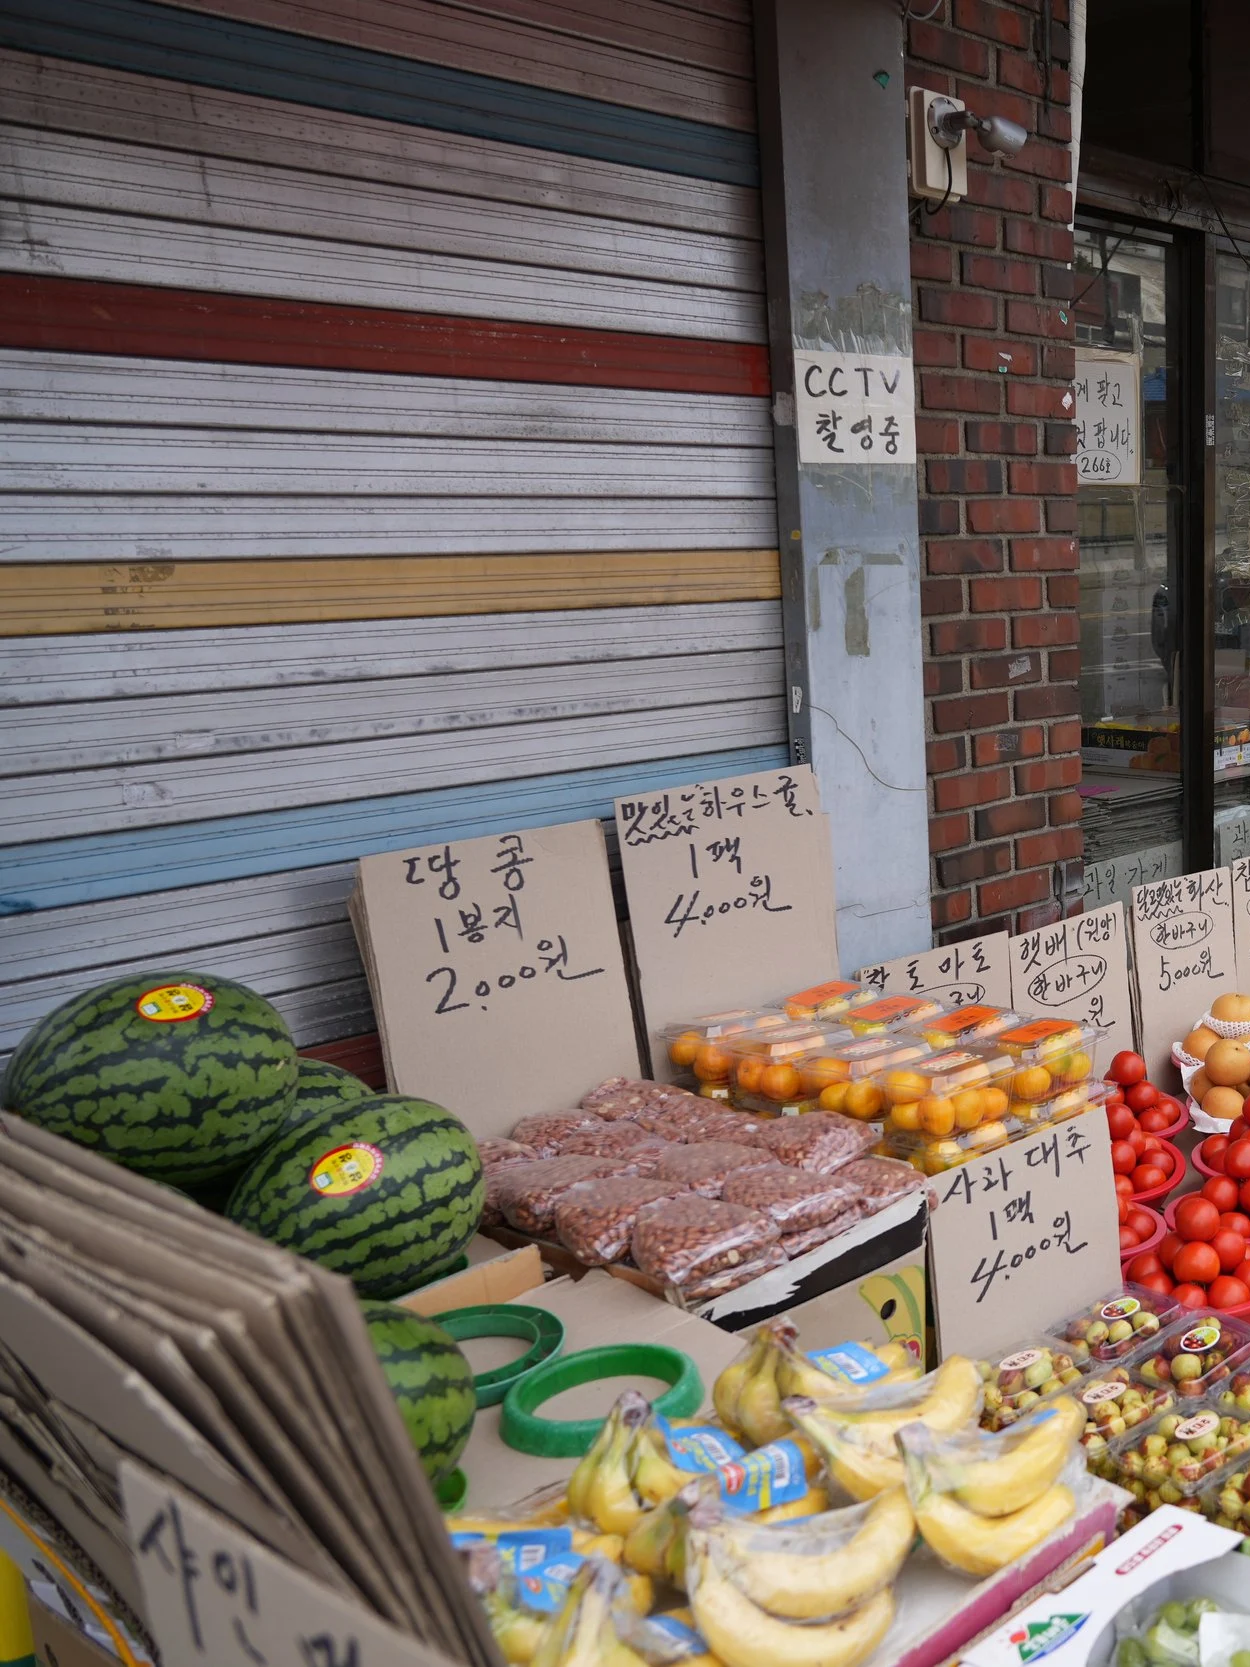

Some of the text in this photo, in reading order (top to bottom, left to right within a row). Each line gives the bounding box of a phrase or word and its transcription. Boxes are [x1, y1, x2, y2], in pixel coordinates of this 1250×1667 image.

[803, 365, 901, 398] CCTV
[1096, 371, 1124, 407] 팔고
[1080, 456, 1111, 474] 266호
[664, 875, 793, 938] 4.000원
[1020, 924, 1068, 974] 햇배
[1156, 918, 1208, 946] 한바구니
[426, 935, 606, 1015] 2.000원
[1031, 960, 1105, 1001] 한바구니
[1159, 946, 1225, 992] 5.000원
[942, 1125, 1092, 1204] 사과 대추
[970, 1210, 1089, 1303] 4.000원
